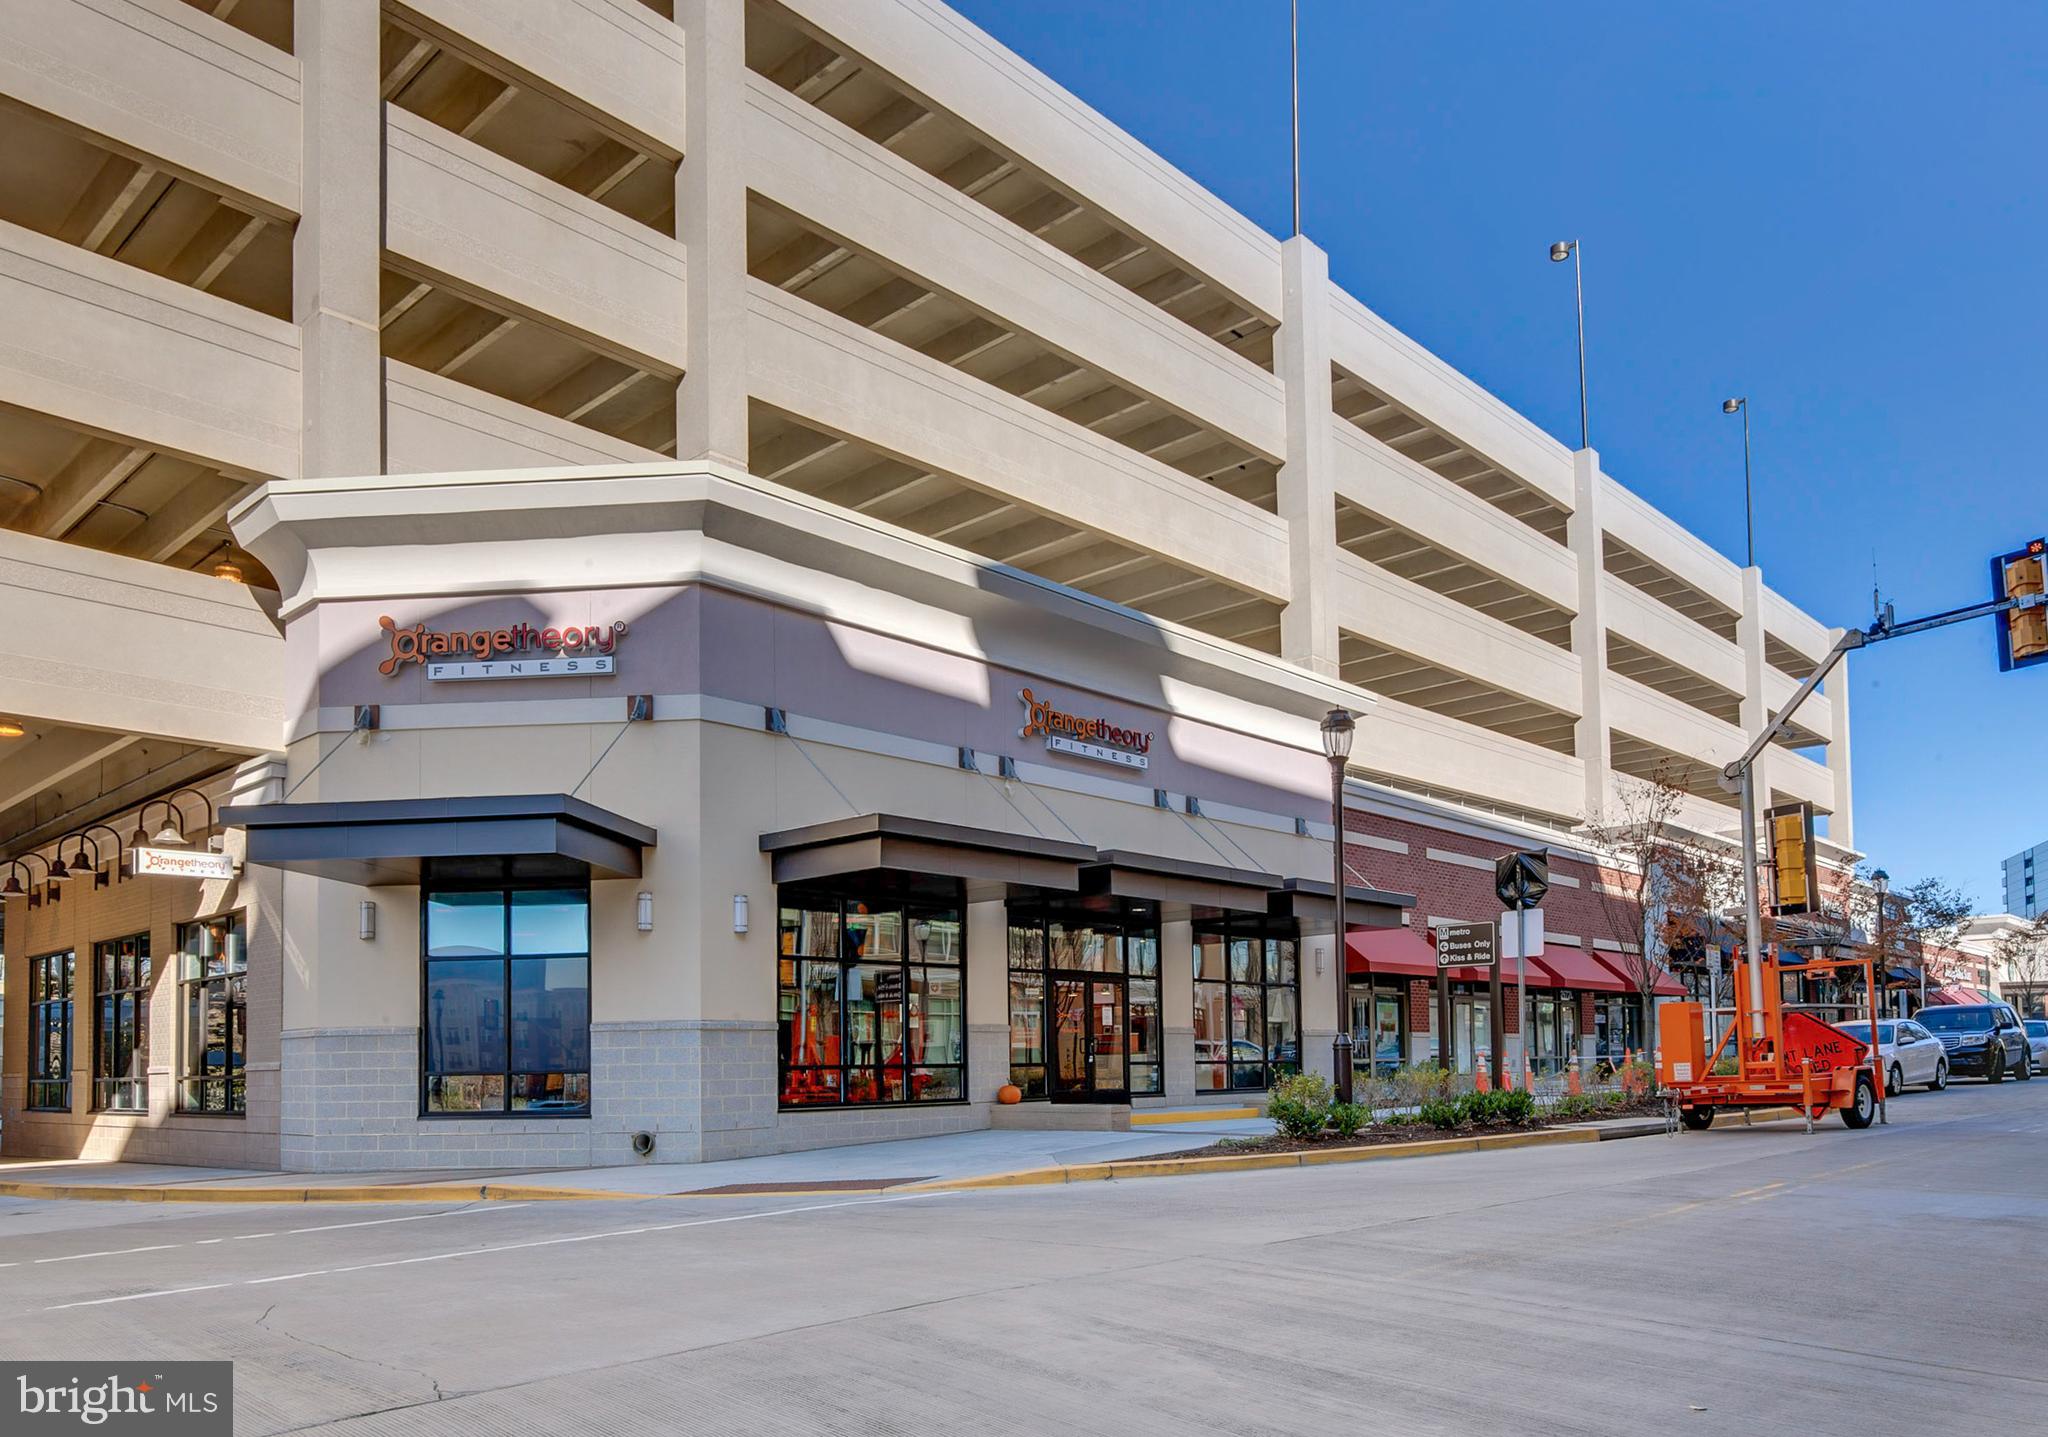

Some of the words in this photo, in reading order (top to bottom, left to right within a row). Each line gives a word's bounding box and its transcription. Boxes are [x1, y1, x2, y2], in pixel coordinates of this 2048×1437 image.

[433, 659, 607, 676] FITNESS
[1055, 738, 1146, 766] FITNESS
[1450, 942, 1472, 950] Buses
[1474, 940, 1491, 948] Only
[1450, 953, 1466, 961] Kiss
[1474, 952, 1491, 960] Ride
[1803, 1041, 1842, 1058] LANE
